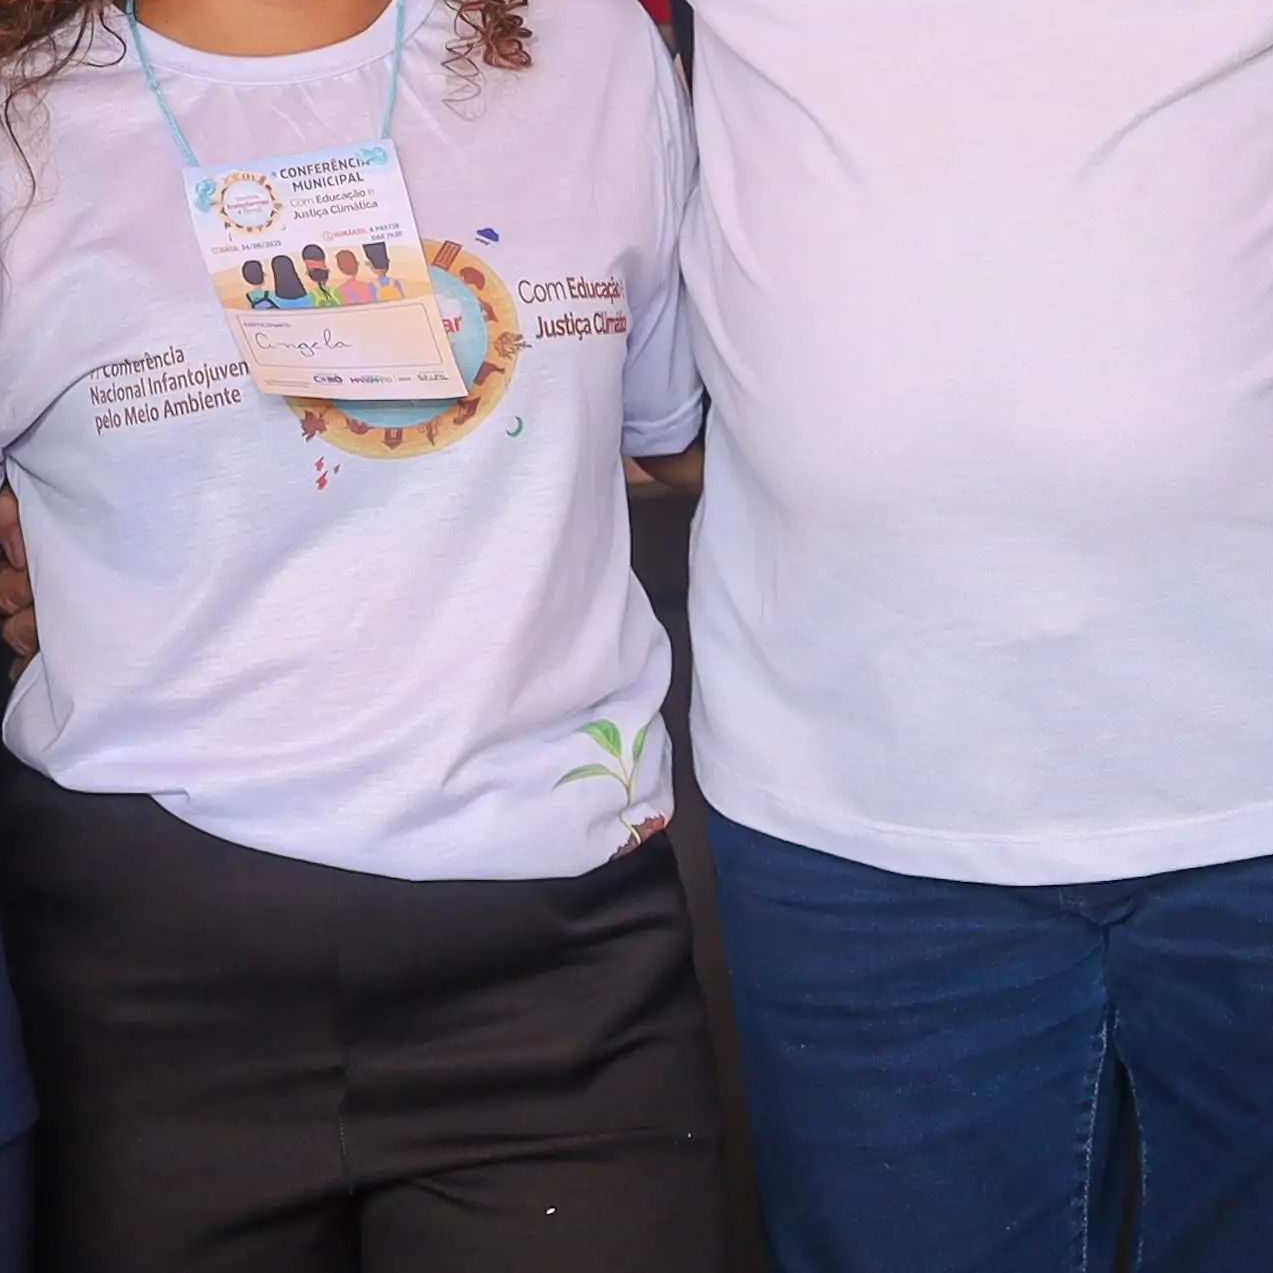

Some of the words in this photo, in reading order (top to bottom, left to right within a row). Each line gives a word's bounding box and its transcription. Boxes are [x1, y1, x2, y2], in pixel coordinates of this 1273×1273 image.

[291, 171, 365, 193] MUNICIPAL
[289, 197, 315, 208] Com
[315, 189, 366, 205] Educação
[292, 206, 329, 221] Justiça
[329, 200, 379, 215] Climática
[518, 279, 567, 305] Com
[535, 314, 591, 341] Justiça
[89, 376, 146, 406] Nacional
[95, 409, 122, 436] pelo
[124, 401, 159, 426] Meio
[163, 387, 241, 419] Ambiente
